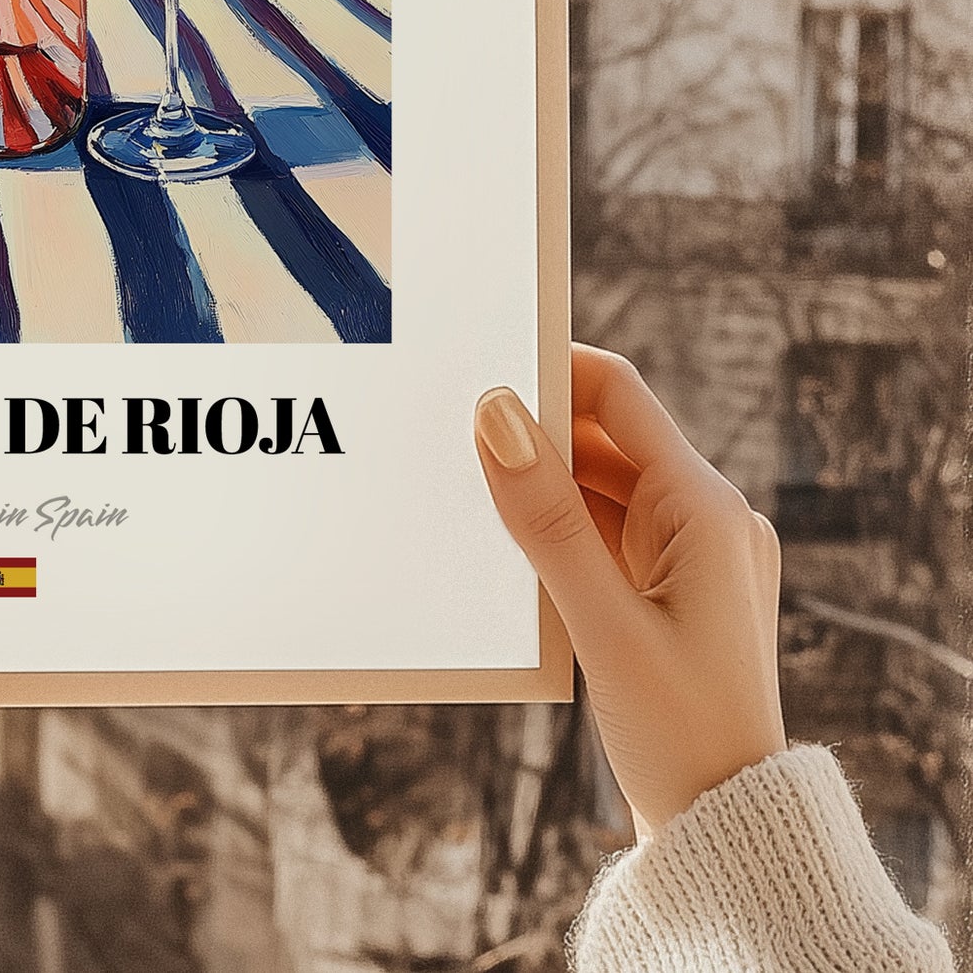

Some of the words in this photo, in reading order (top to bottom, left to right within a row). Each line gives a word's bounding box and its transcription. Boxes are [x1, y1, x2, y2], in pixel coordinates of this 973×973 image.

[4, 397, 107, 455] DE
[122, 397, 345, 455] RIOJA
[33, 496, 129, 541] Spain
